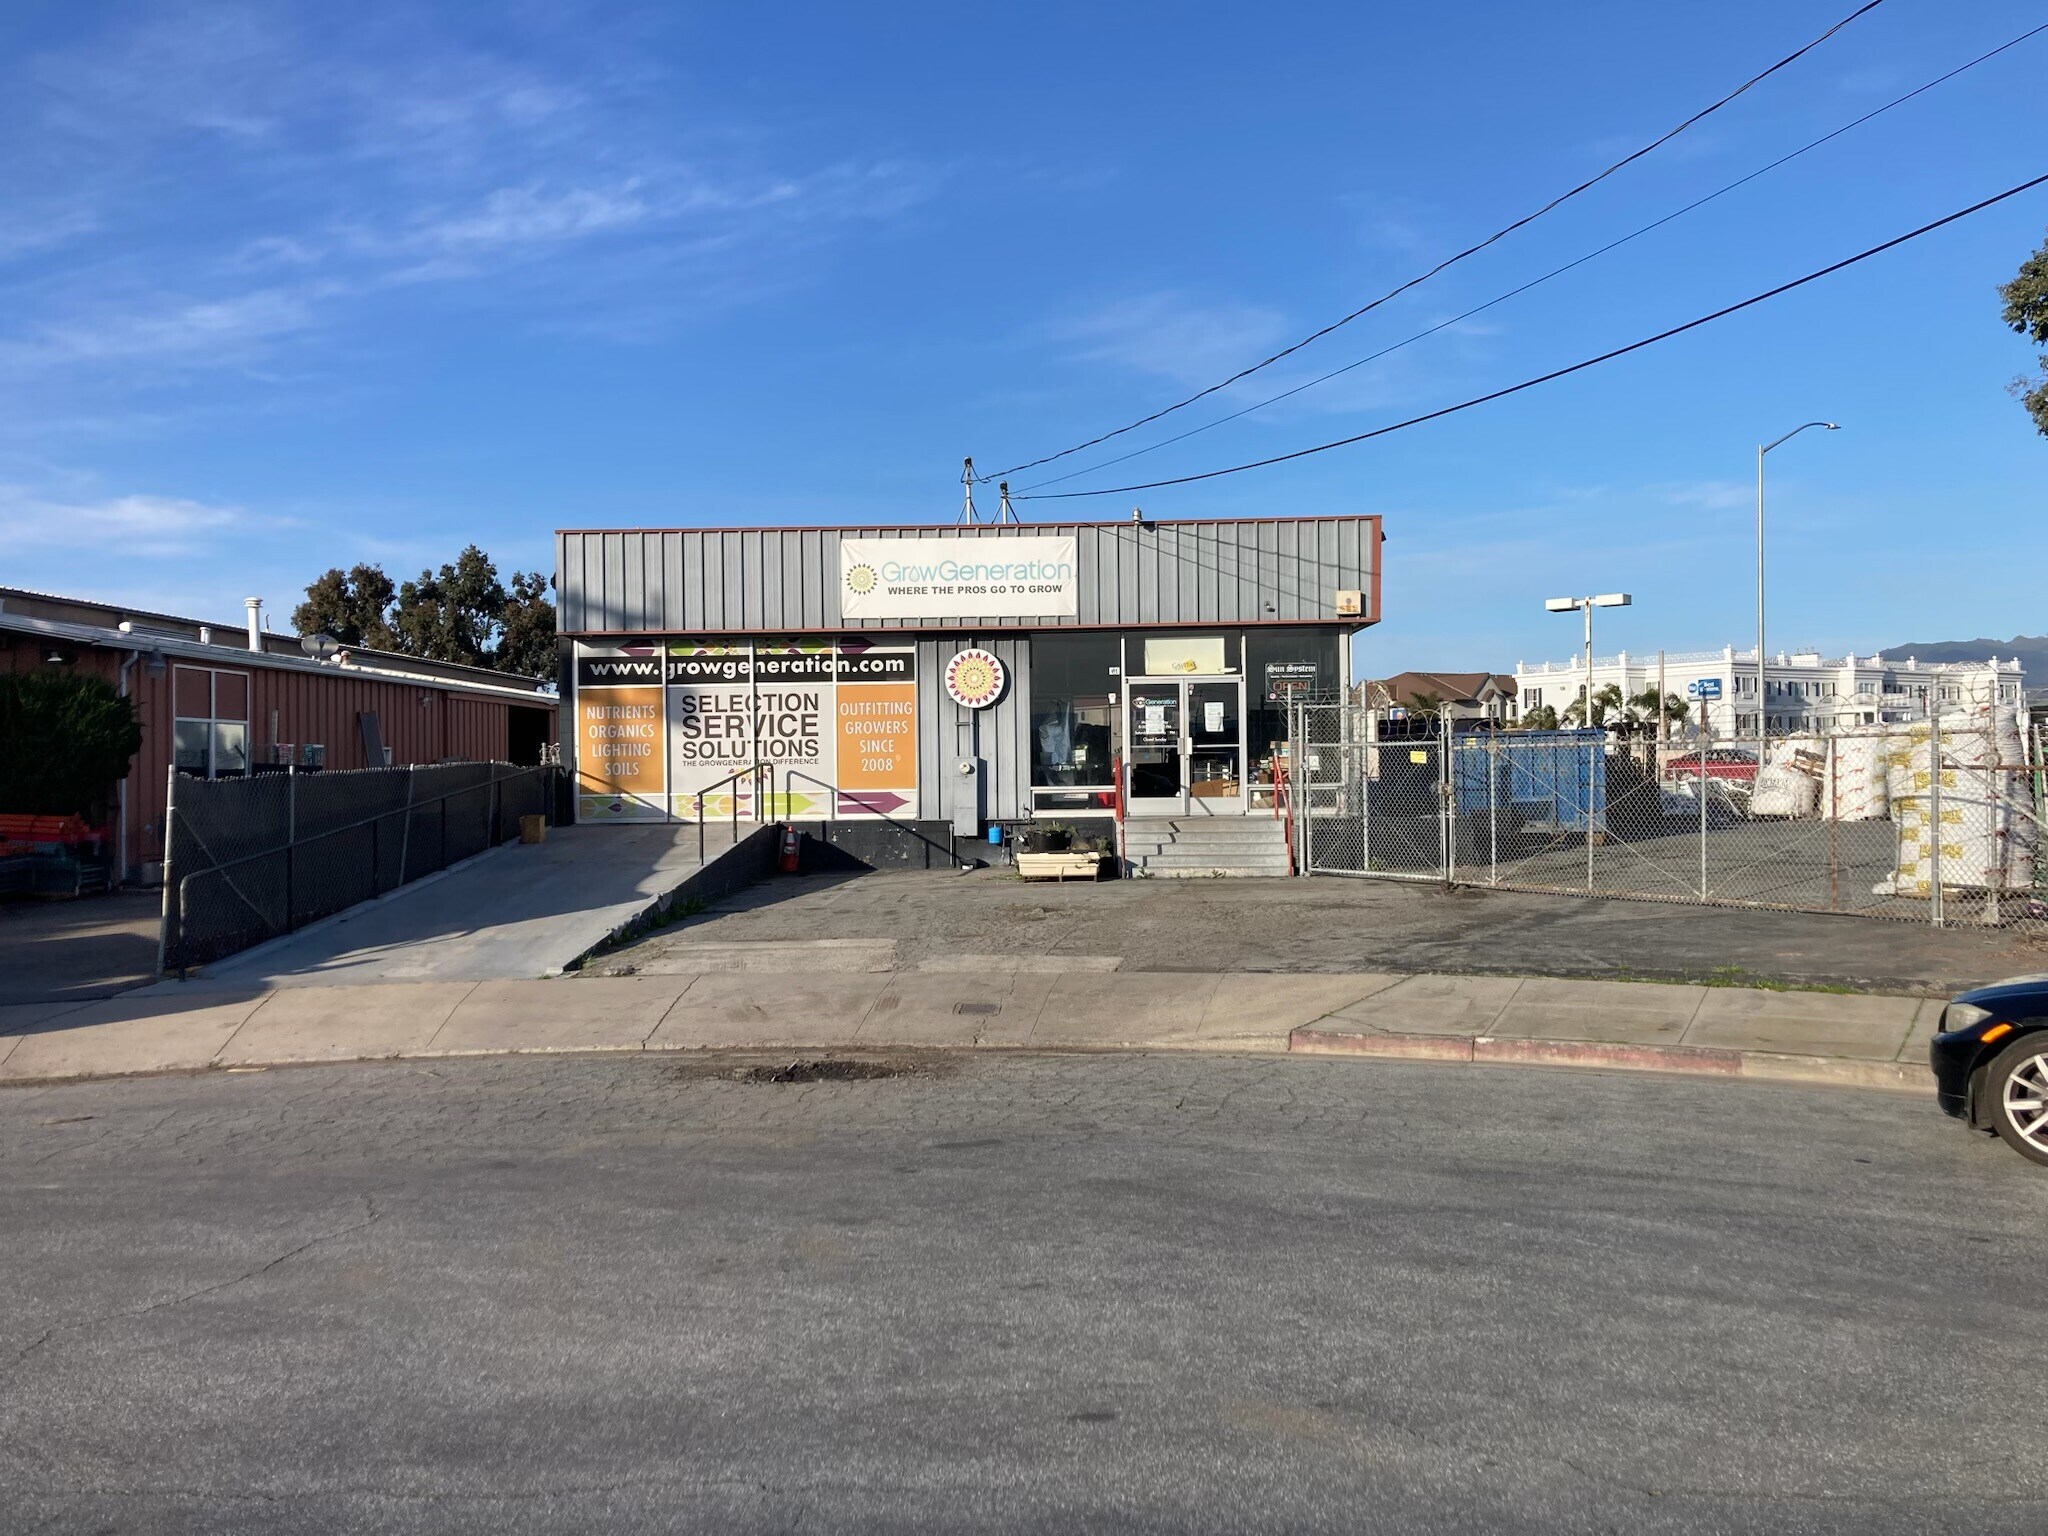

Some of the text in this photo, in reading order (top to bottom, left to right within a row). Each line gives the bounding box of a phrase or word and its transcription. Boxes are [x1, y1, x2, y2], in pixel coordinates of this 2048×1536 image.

[882, 560, 1072, 583] GrowGeneration
[888, 584, 1063, 595] WHERE THE PROS GO TO GROW
[589, 654, 905, 680] www.growgeneration.com
[1267, 664, 1316, 673] Sun System
[1273, 681, 1308, 691] OPEN
[682, 693, 819, 713] SELECTION
[840, 702, 913, 716] OUTFITTING
[586, 705, 656, 719] NUTRIENTS
[588, 724, 655, 738] ORGANICS
[682, 713, 819, 739] SERVICE
[845, 721, 909, 734] GROWERS
[592, 743, 651, 757] LIGHTING
[860, 740, 895, 753] SINCE
[604, 762, 640, 776] SOILS
[861, 758, 894, 772] 2008
